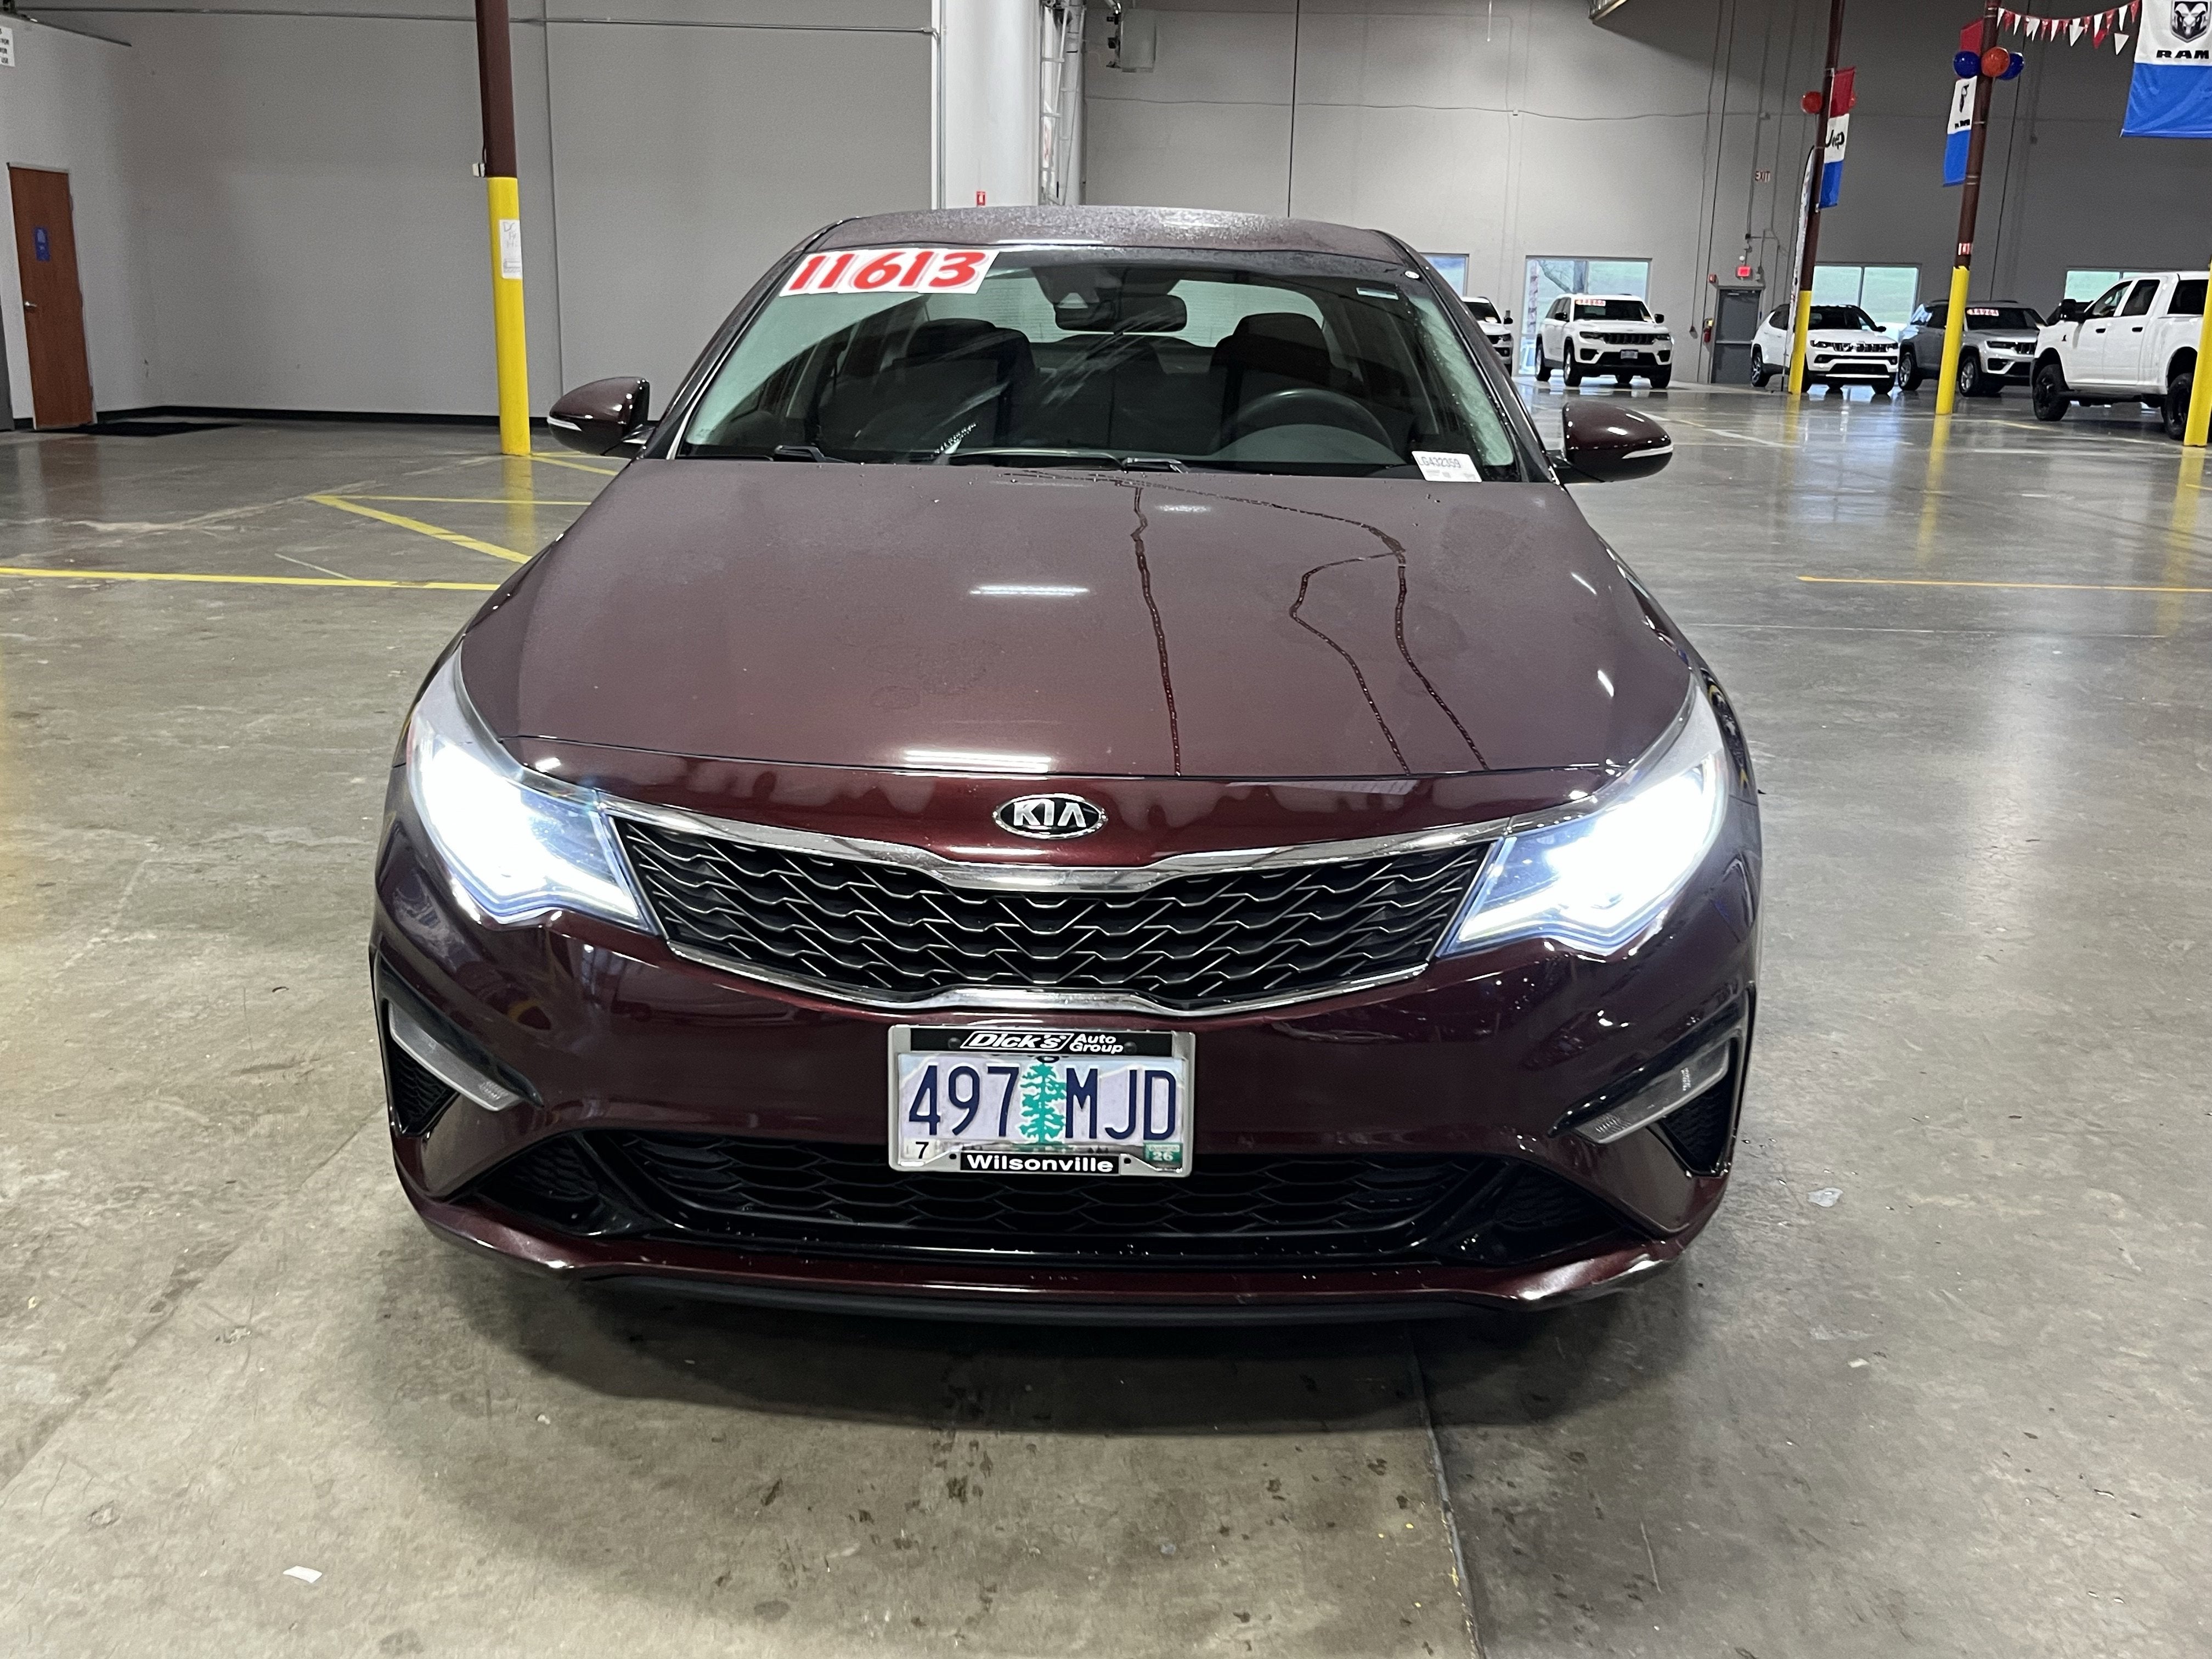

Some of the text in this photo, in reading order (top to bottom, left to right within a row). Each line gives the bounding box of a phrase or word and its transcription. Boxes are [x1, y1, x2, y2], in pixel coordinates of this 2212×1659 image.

[2156, 50, 2209, 59] RAM
[1755, 171, 1770, 182] EXIT
[788, 250, 988, 290] 11613
[1013, 799, 1087, 827] KIA
[969, 1034, 1116, 1049] Dick's Auto
[1069, 1042, 1124, 1054] Group
[909, 1065, 1177, 1141] 497 MJD
[916, 1142, 929, 1159] 7
[1153, 1152, 1173, 1161] 26
[966, 1154, 1114, 1173] Wilsonville
